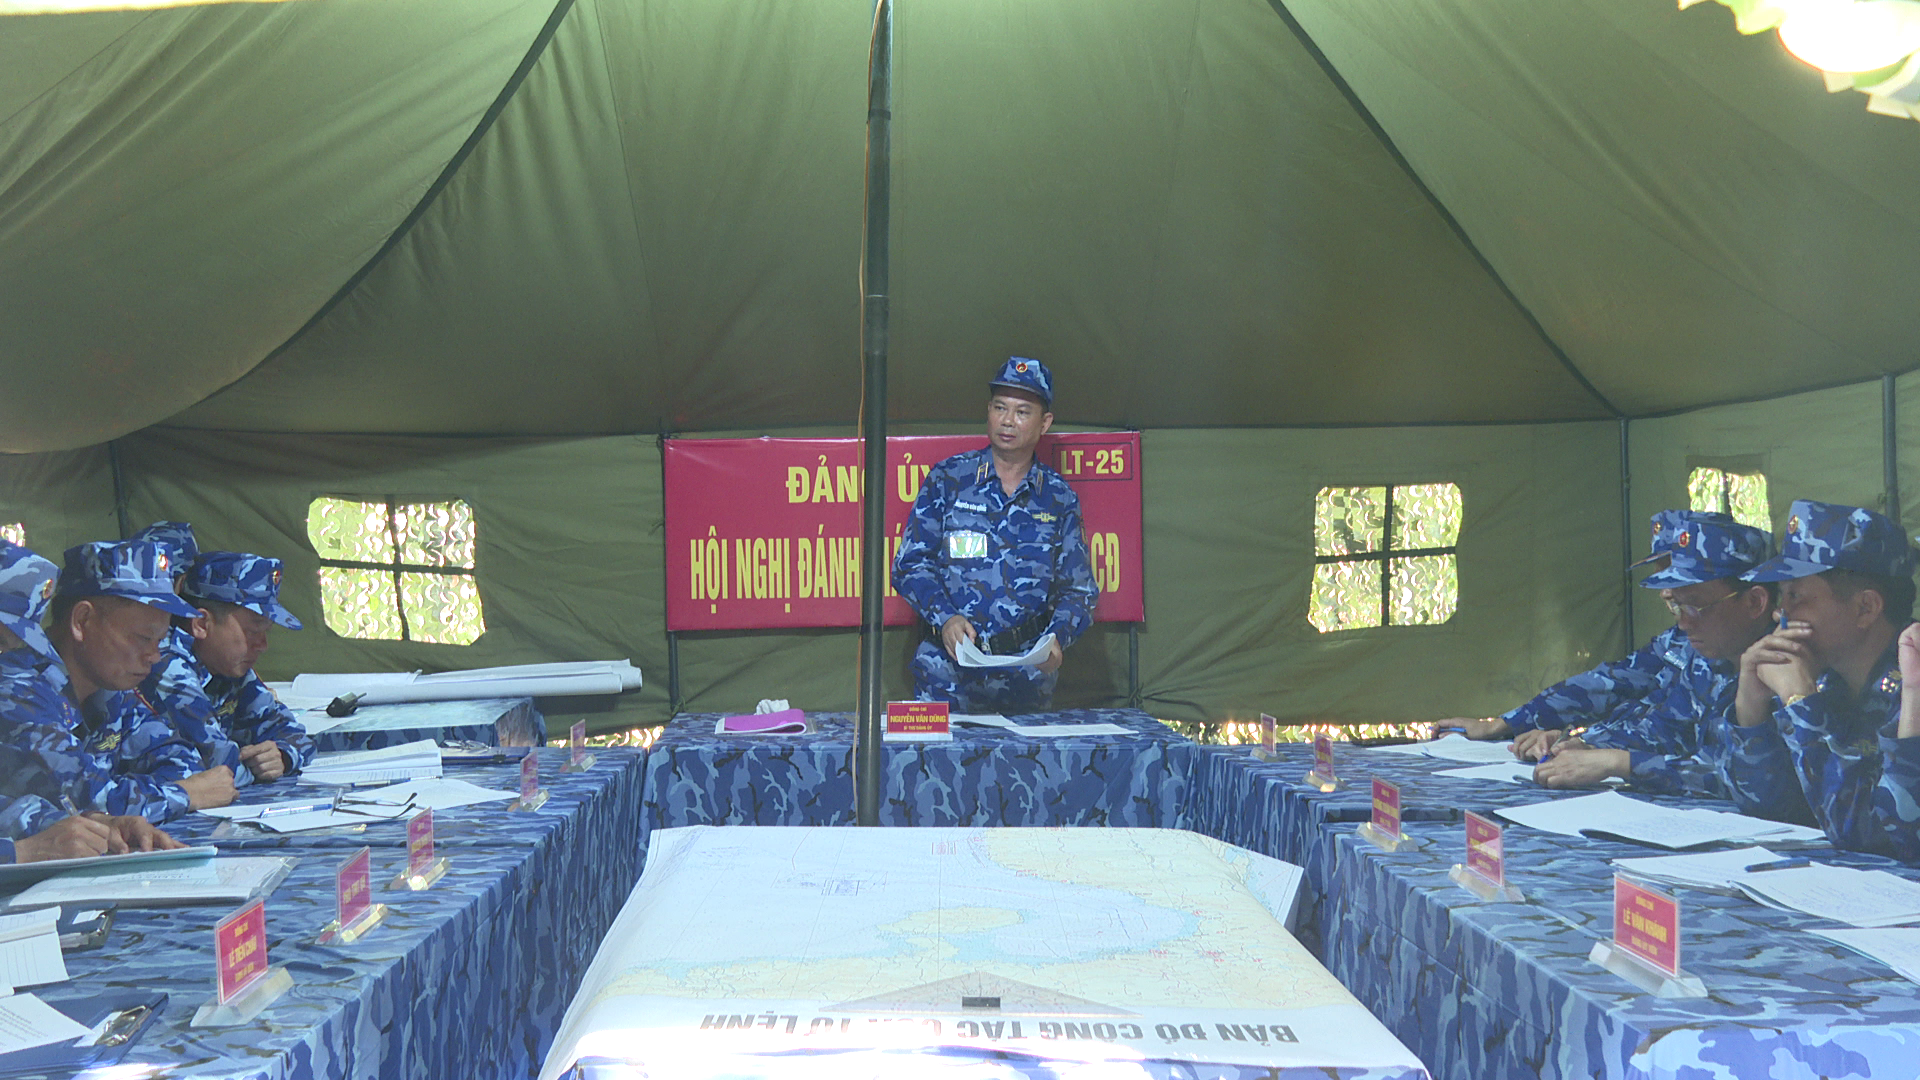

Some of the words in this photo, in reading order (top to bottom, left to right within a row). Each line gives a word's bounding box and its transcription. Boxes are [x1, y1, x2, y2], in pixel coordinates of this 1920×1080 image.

[1061, 450, 1124, 475] LT-25
[786, 455, 865, 503] ĐẢN
[690, 525, 728, 614] HỘI
[736, 537, 791, 613] NGHỊ
[798, 524, 860, 598] ĐÁNH
[916, 713, 928, 722] VĂN
[956, 1020, 1028, 1042] TÁC
[1039, 1021, 1143, 1043] CÔNG
[1155, 1022, 1208, 1045] ĐỒ
[1214, 1022, 1300, 1047] BẢN
